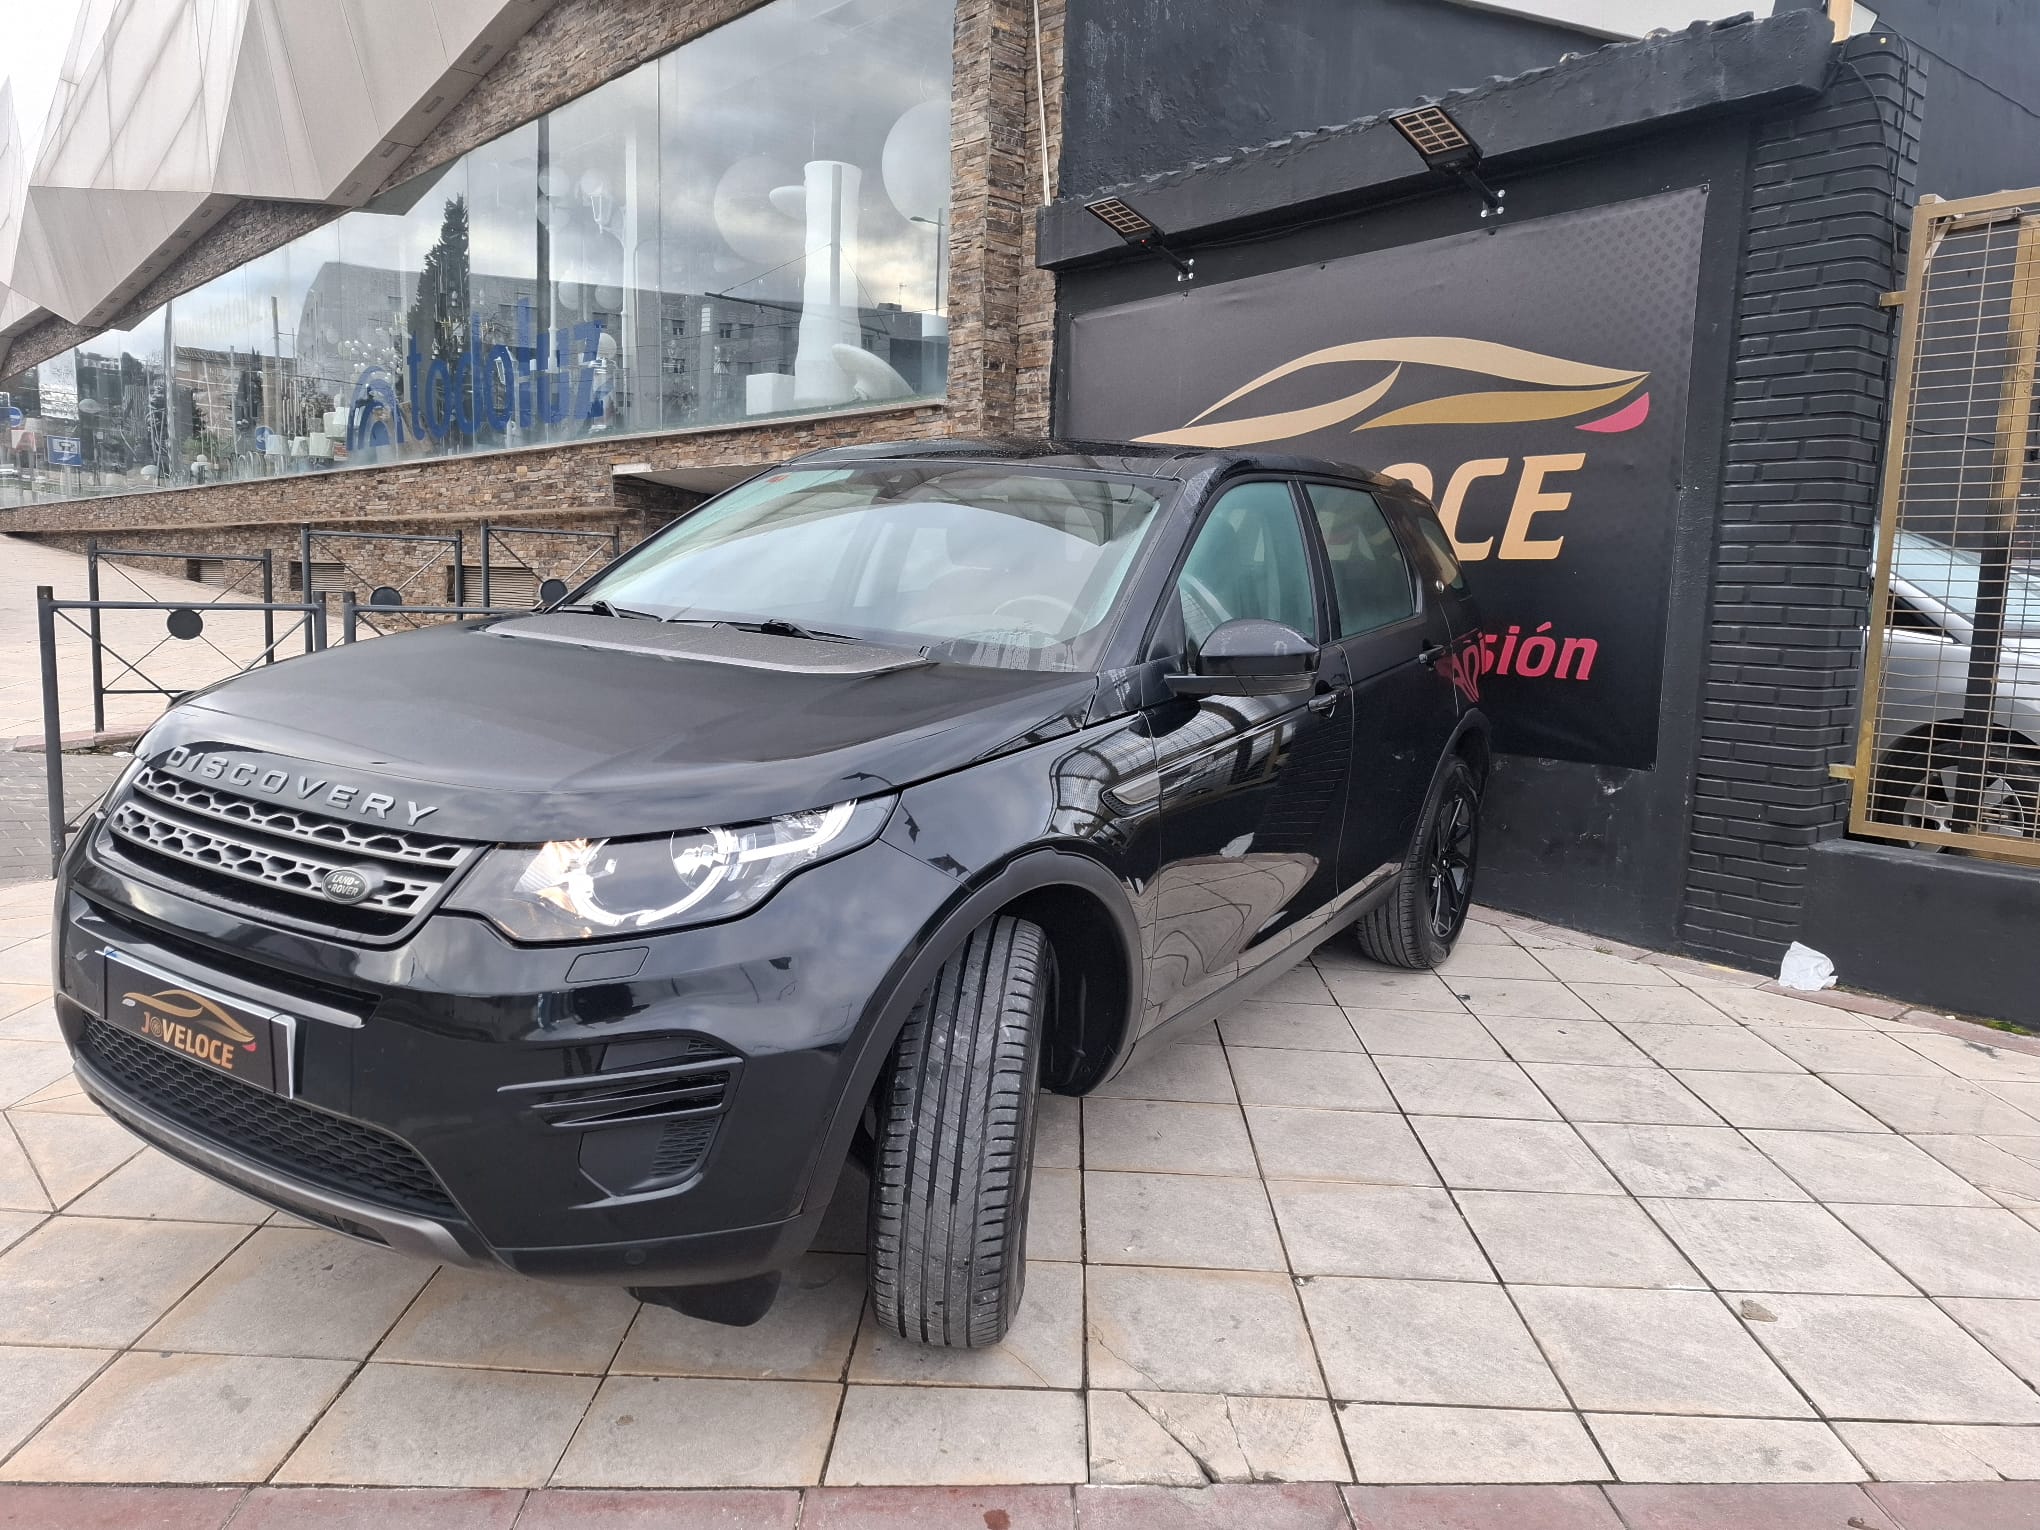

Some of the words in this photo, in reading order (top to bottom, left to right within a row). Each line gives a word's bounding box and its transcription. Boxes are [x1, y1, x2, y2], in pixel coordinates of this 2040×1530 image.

[165, 745, 438, 826] DISCOVERY
[332, 875, 355, 886] LAND
[330, 883, 359, 896] ROVER
